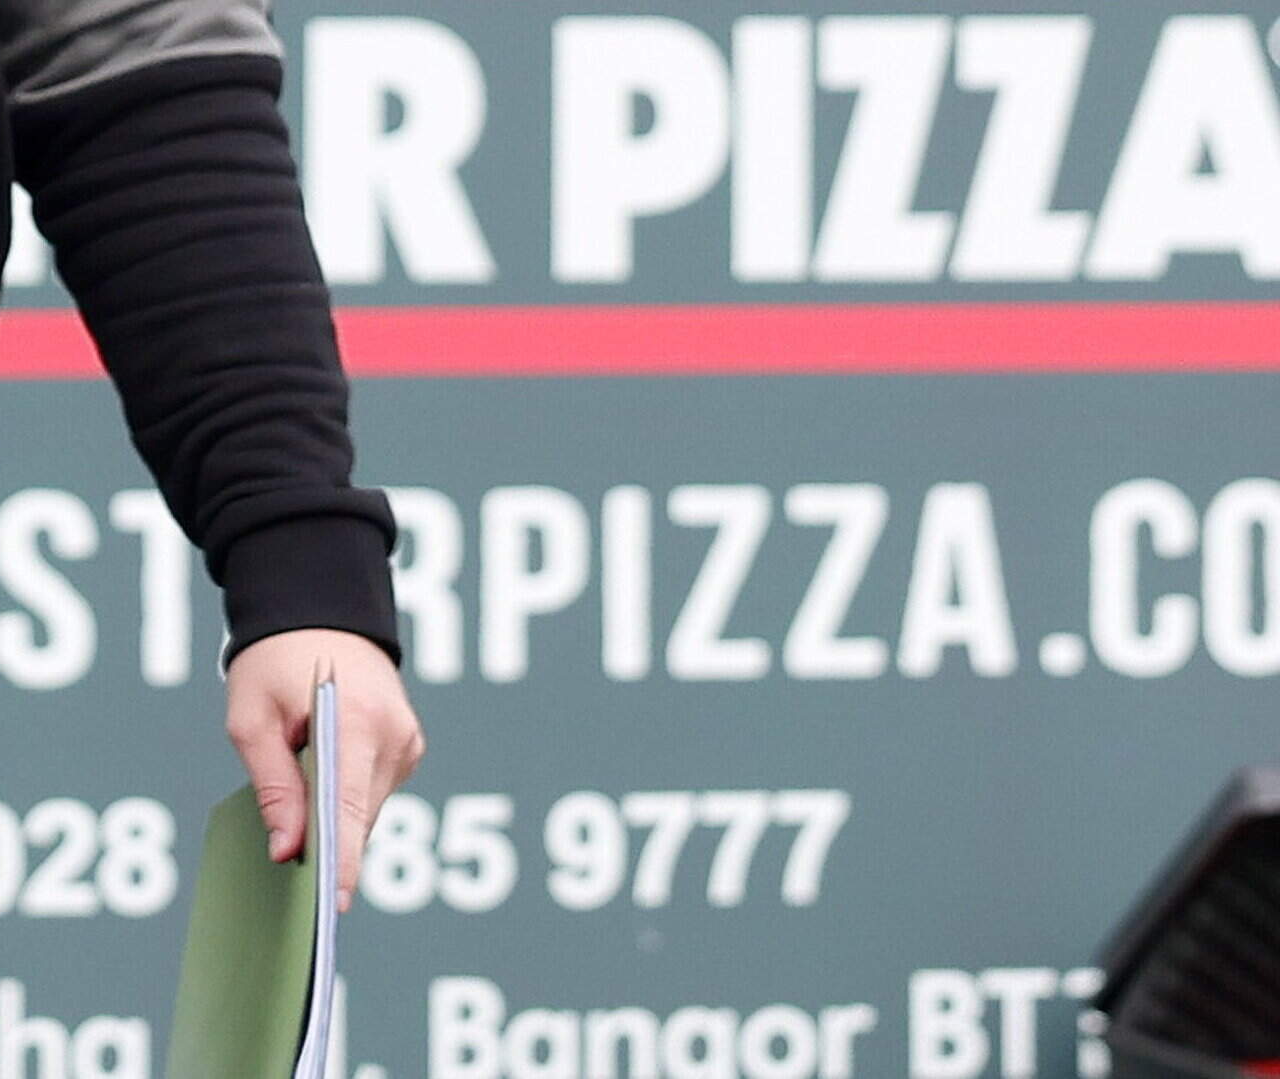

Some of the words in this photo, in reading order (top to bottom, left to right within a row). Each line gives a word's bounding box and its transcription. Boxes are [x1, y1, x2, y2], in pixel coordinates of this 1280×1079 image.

[548, 14, 1280, 284] PIZZA
[357, 791, 519, 914] 85
[543, 788, 851, 911] 9777
[427, 974, 879, 1079] Bangor
